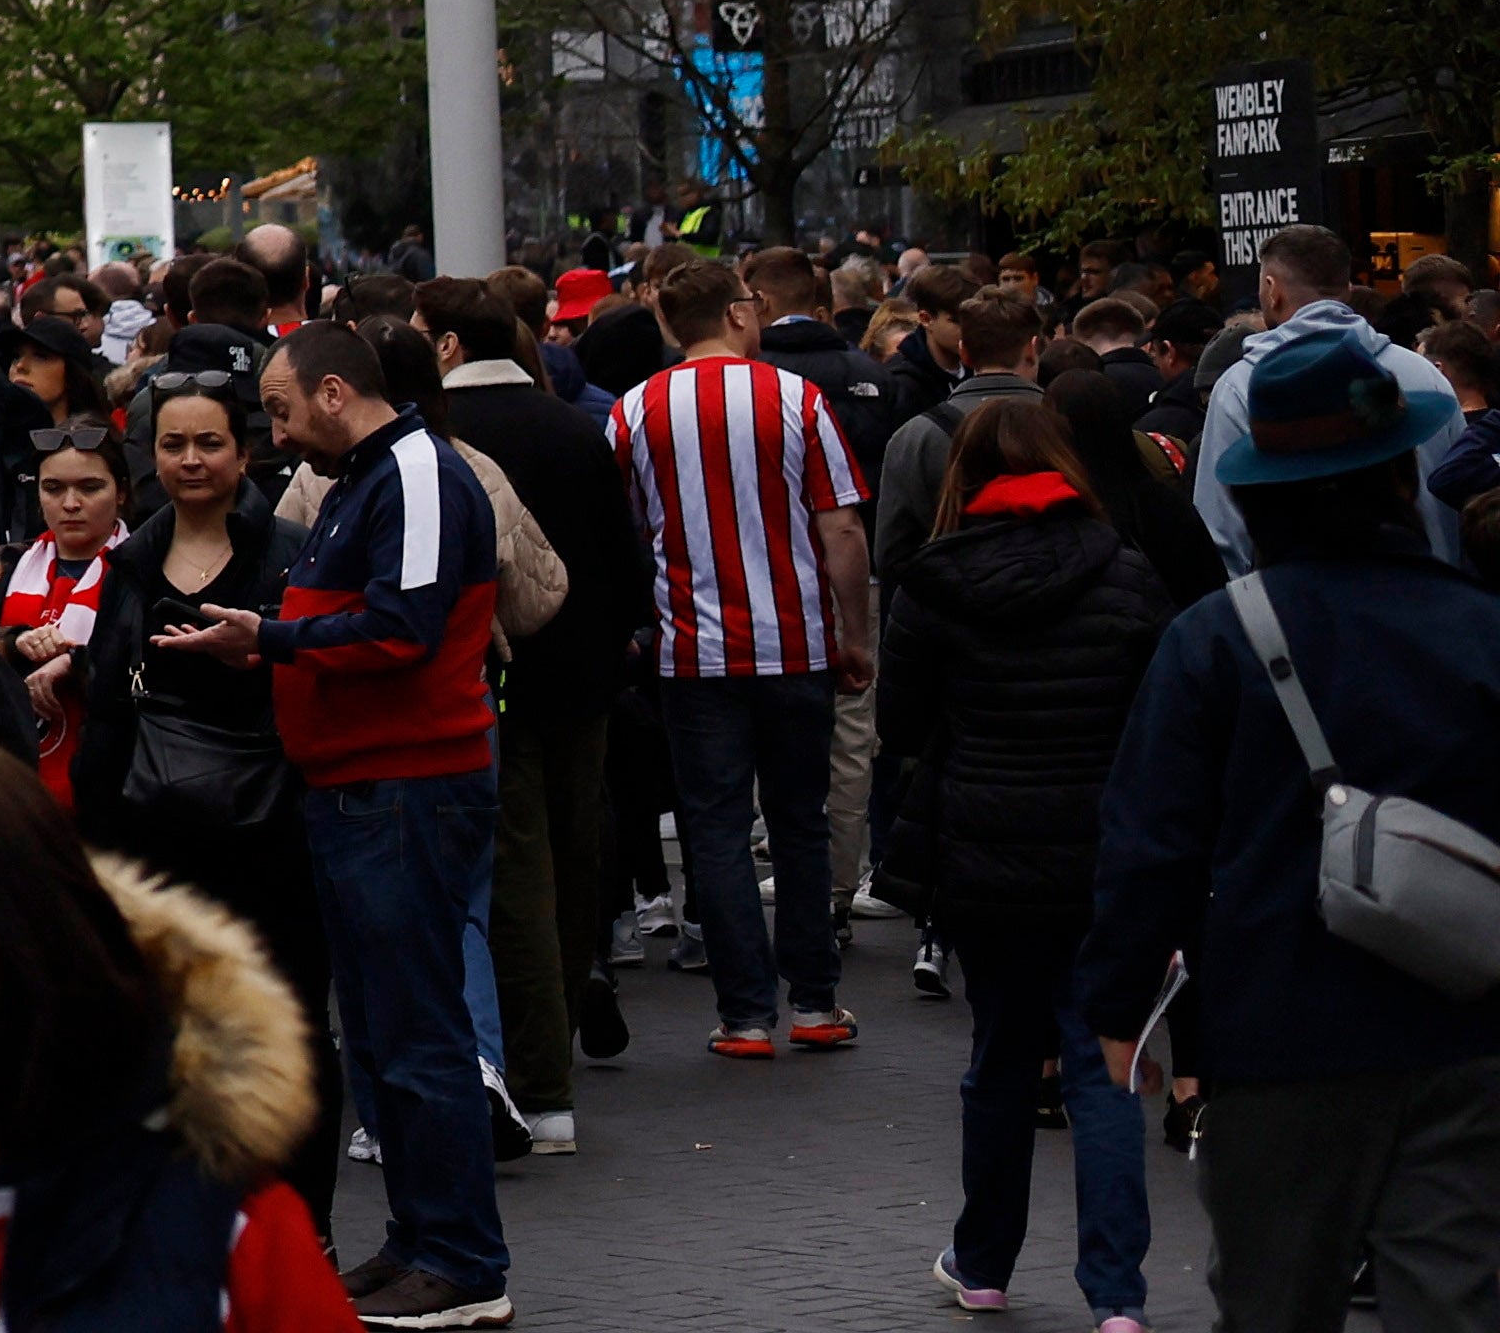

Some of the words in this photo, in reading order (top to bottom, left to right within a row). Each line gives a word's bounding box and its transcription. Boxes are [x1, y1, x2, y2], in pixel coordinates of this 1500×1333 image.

[1215, 79, 1285, 120] WEMBLEY
[1217, 118, 1281, 158] FANPARK
[1220, 187, 1299, 228] ENTRANCE
[1223, 230, 1256, 266] THIS
